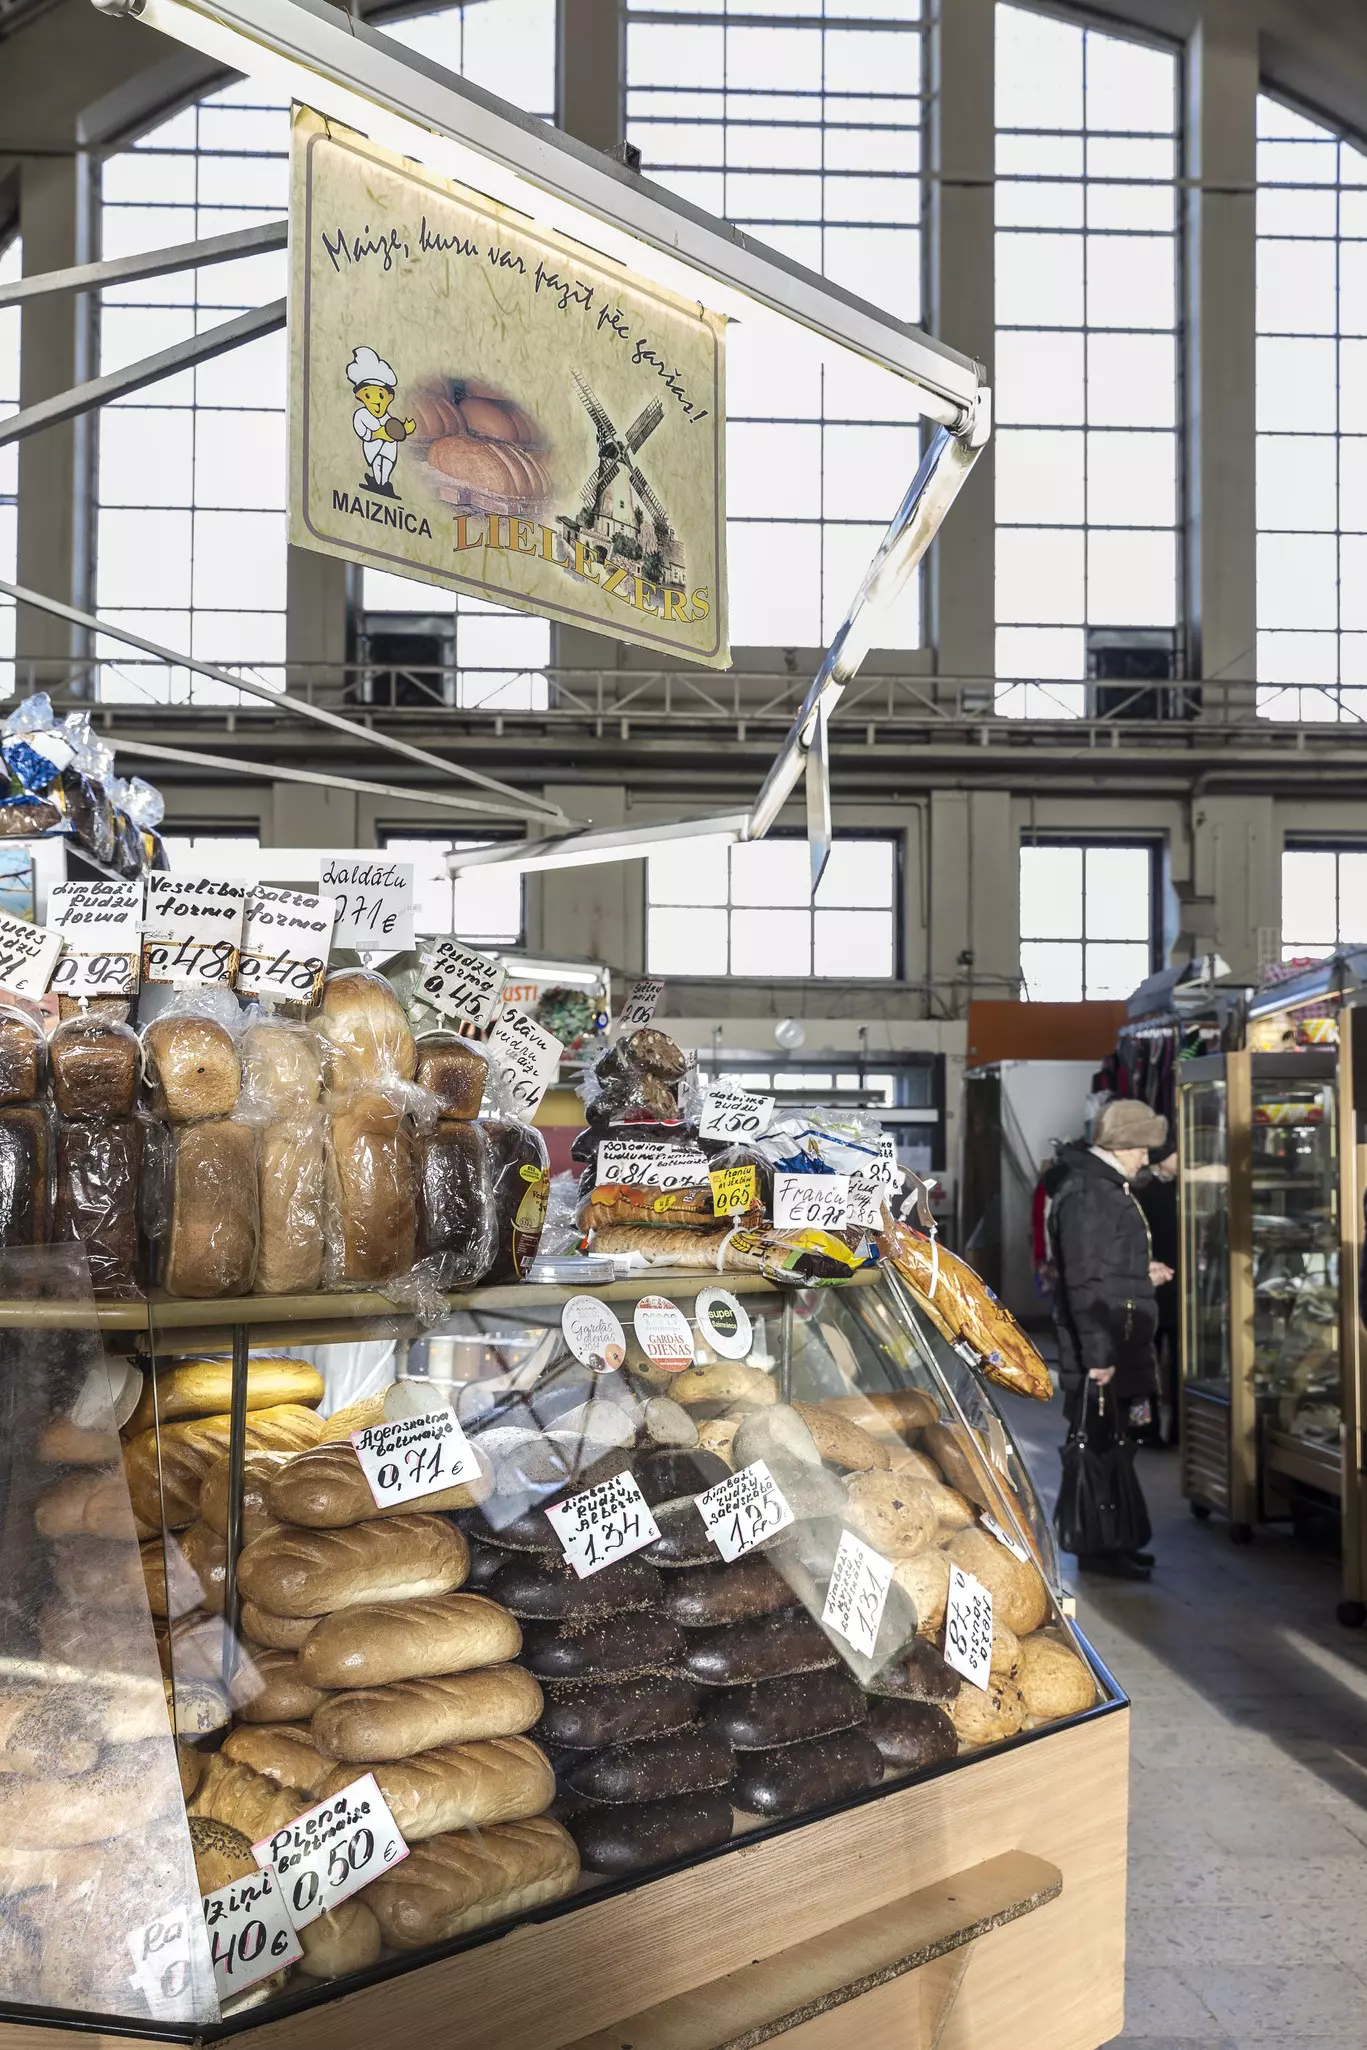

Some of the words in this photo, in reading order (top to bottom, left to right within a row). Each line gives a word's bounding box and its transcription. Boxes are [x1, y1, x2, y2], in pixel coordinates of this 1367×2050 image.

[321, 225, 410, 272] Maize,
[418, 216, 479, 256] kuru
[487, 247, 526, 274] var
[534, 261, 595, 311] pazīt
[597, 304, 629, 339] pēc
[331, 489, 433, 540] MAIZNĪCA
[453, 513, 711, 623] LIELEZERS
[155, 896, 237, 919] forma
[246, 902, 328, 932] forma
[647, 1344, 692, 1356] DIENAS
[377, 1442, 445, 1492] 0,71
[451, 1460, 464, 1476] €
[383, 1840, 398, 1862] €
